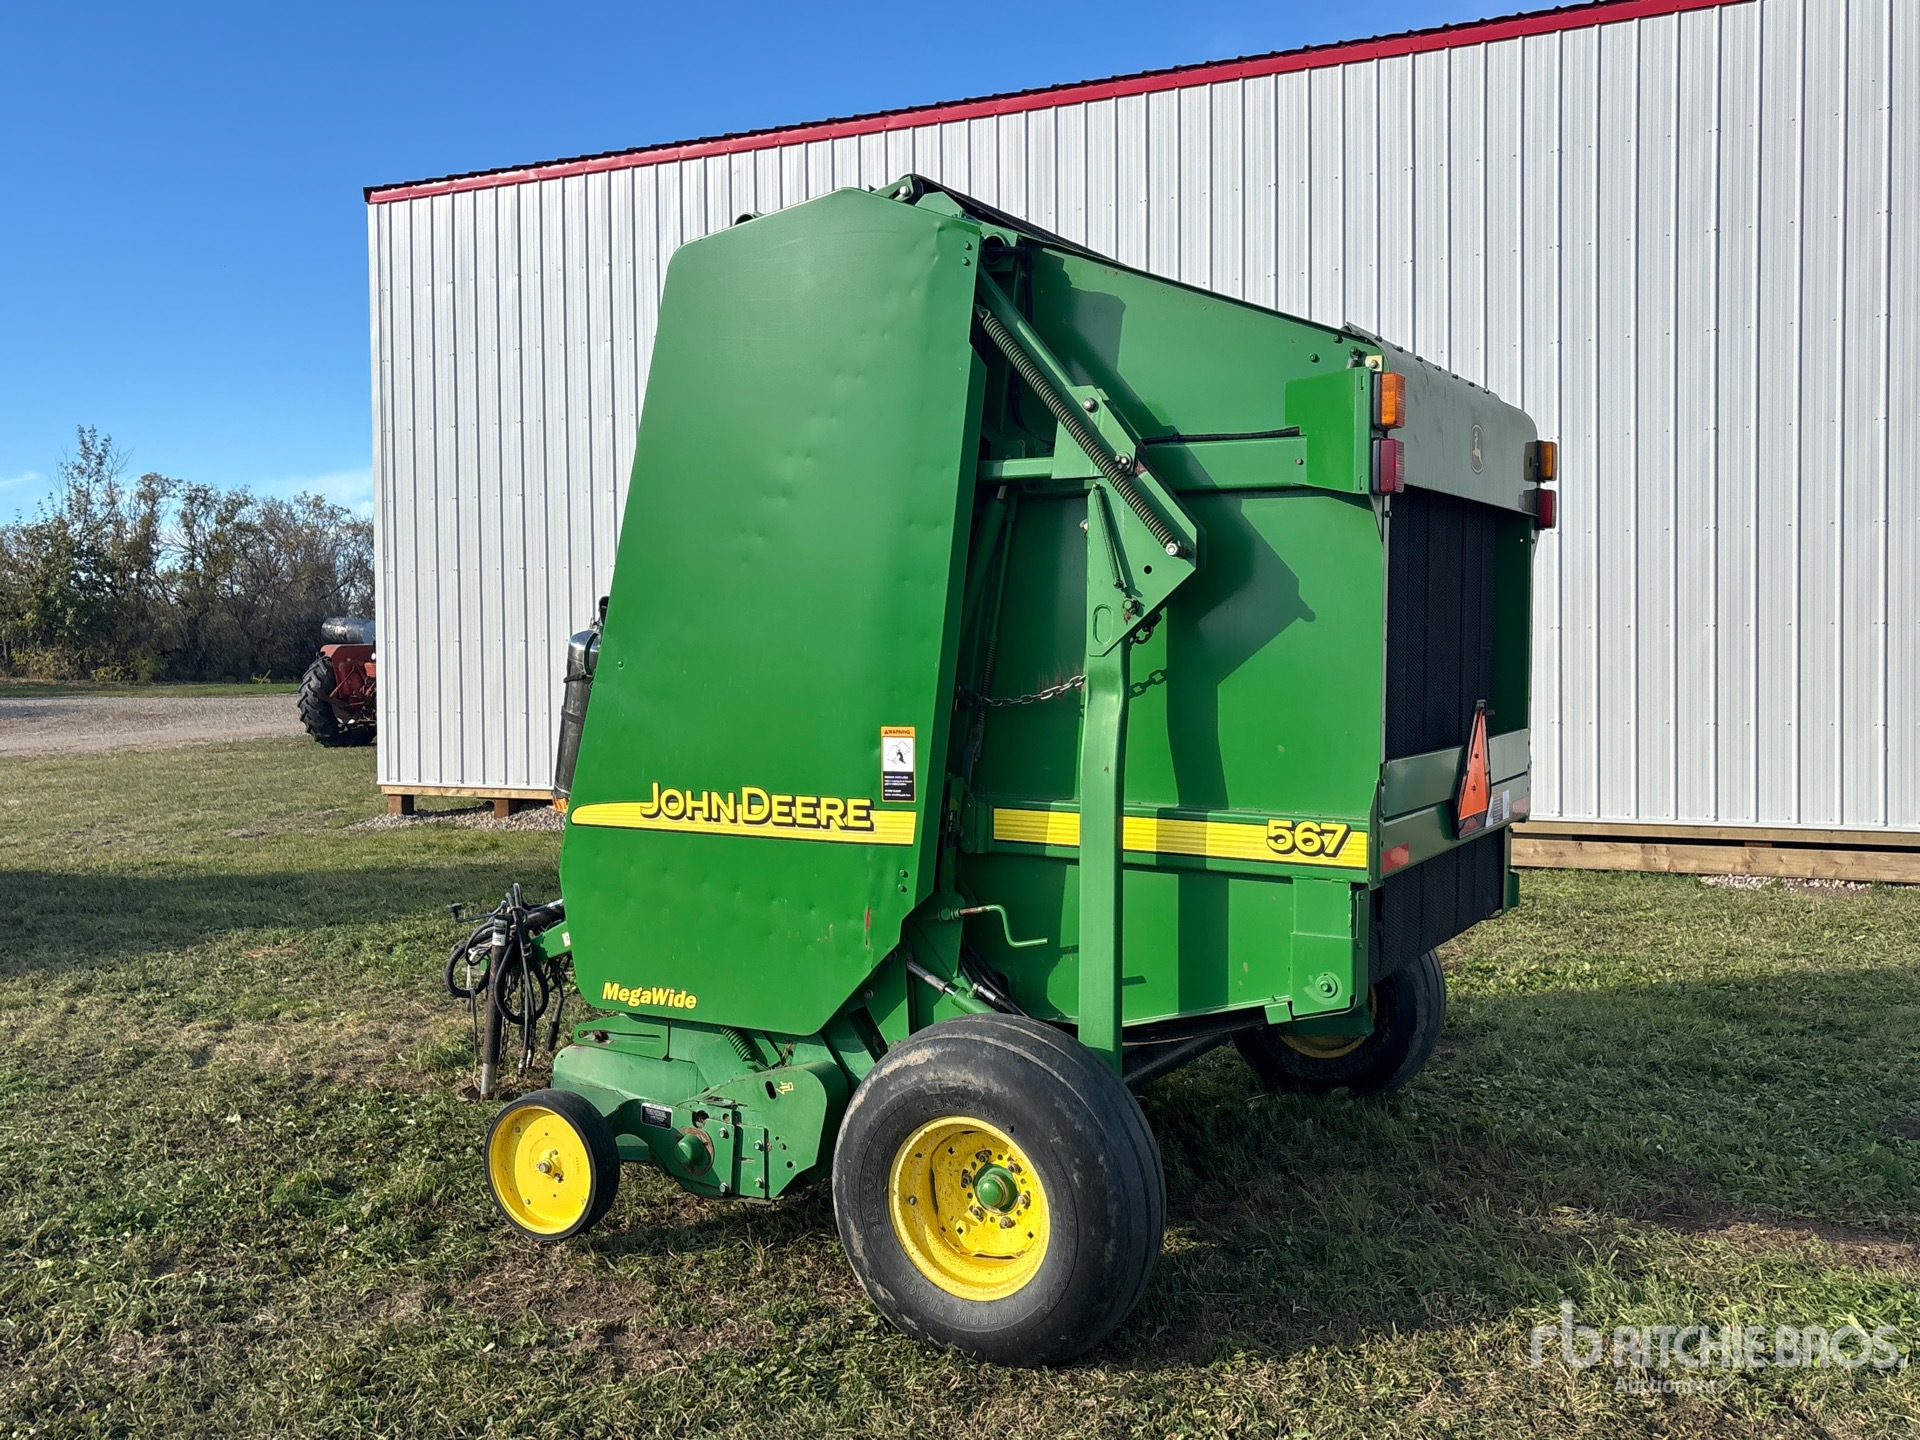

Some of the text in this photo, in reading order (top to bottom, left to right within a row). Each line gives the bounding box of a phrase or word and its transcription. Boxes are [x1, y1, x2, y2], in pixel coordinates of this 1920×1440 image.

[640, 782, 874, 832] JOHN DEERE
[1266, 818, 1351, 858] 567
[602, 981, 697, 1009] MegaWide
